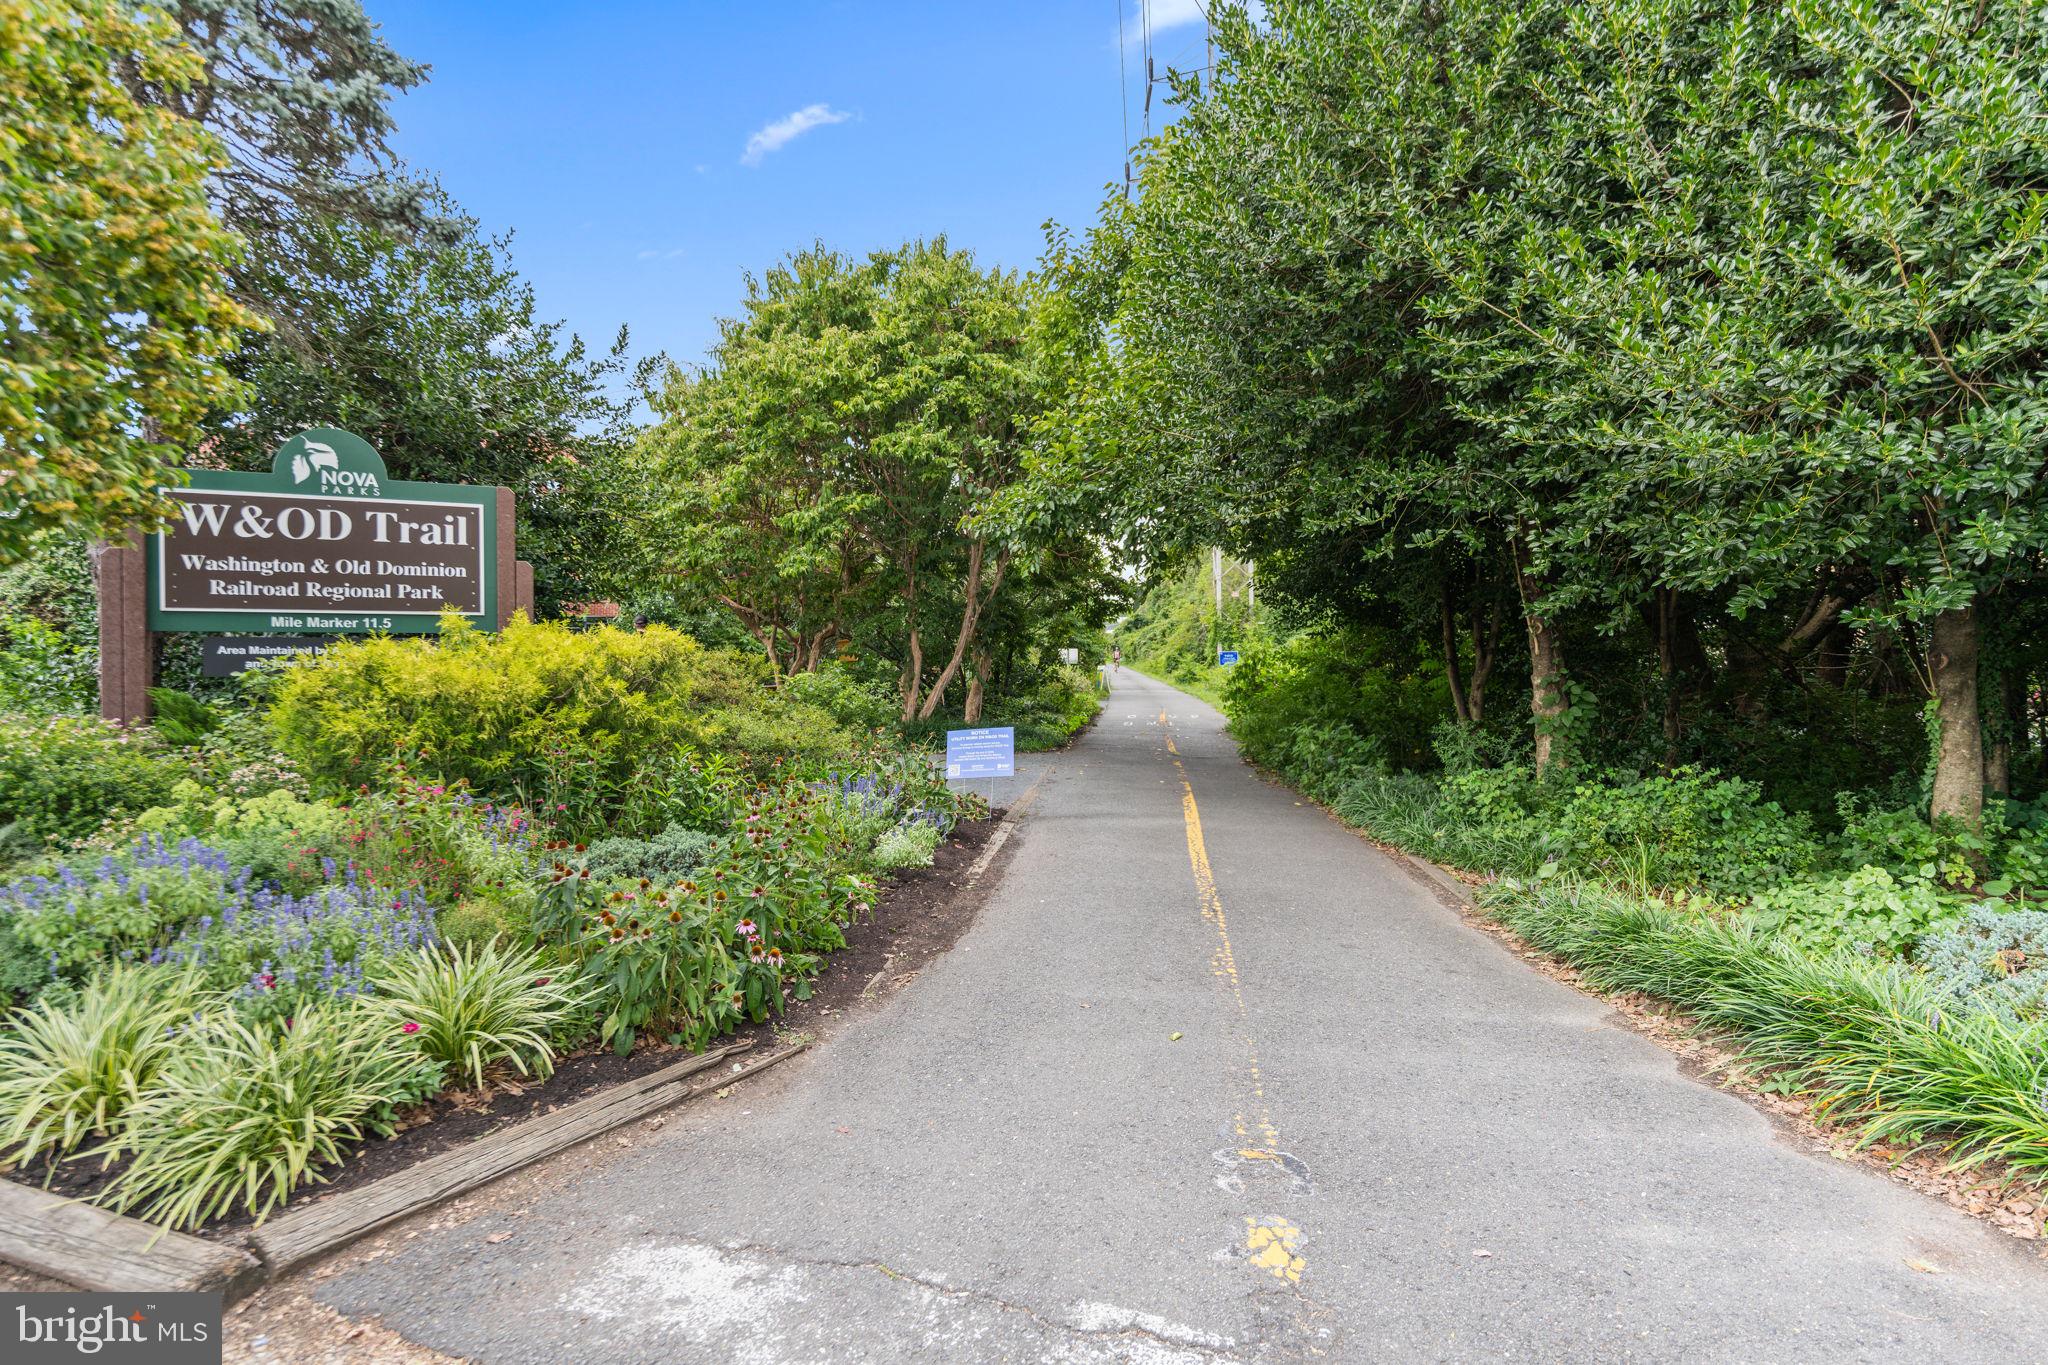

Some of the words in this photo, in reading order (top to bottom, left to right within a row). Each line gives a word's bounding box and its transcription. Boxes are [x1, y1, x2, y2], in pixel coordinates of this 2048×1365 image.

[321, 470, 379, 487] NOVA
[321, 485, 380, 496] PARKS
[181, 502, 352, 541] W&OD
[365, 511, 468, 546] Trail
[181, 554, 305, 576] Washington
[310, 558, 329, 574] &
[335, 558, 371, 575] Old
[377, 560, 467, 578] Dominion
[209, 579, 299, 597] Railroad
[306, 582, 392, 601] Regional
[398, 583, 444, 600] Park
[271, 616, 303, 628] Mile
[306, 616, 359, 628] Marker
[362, 617, 392, 629] 11.5
[216, 645, 246, 655] Area
